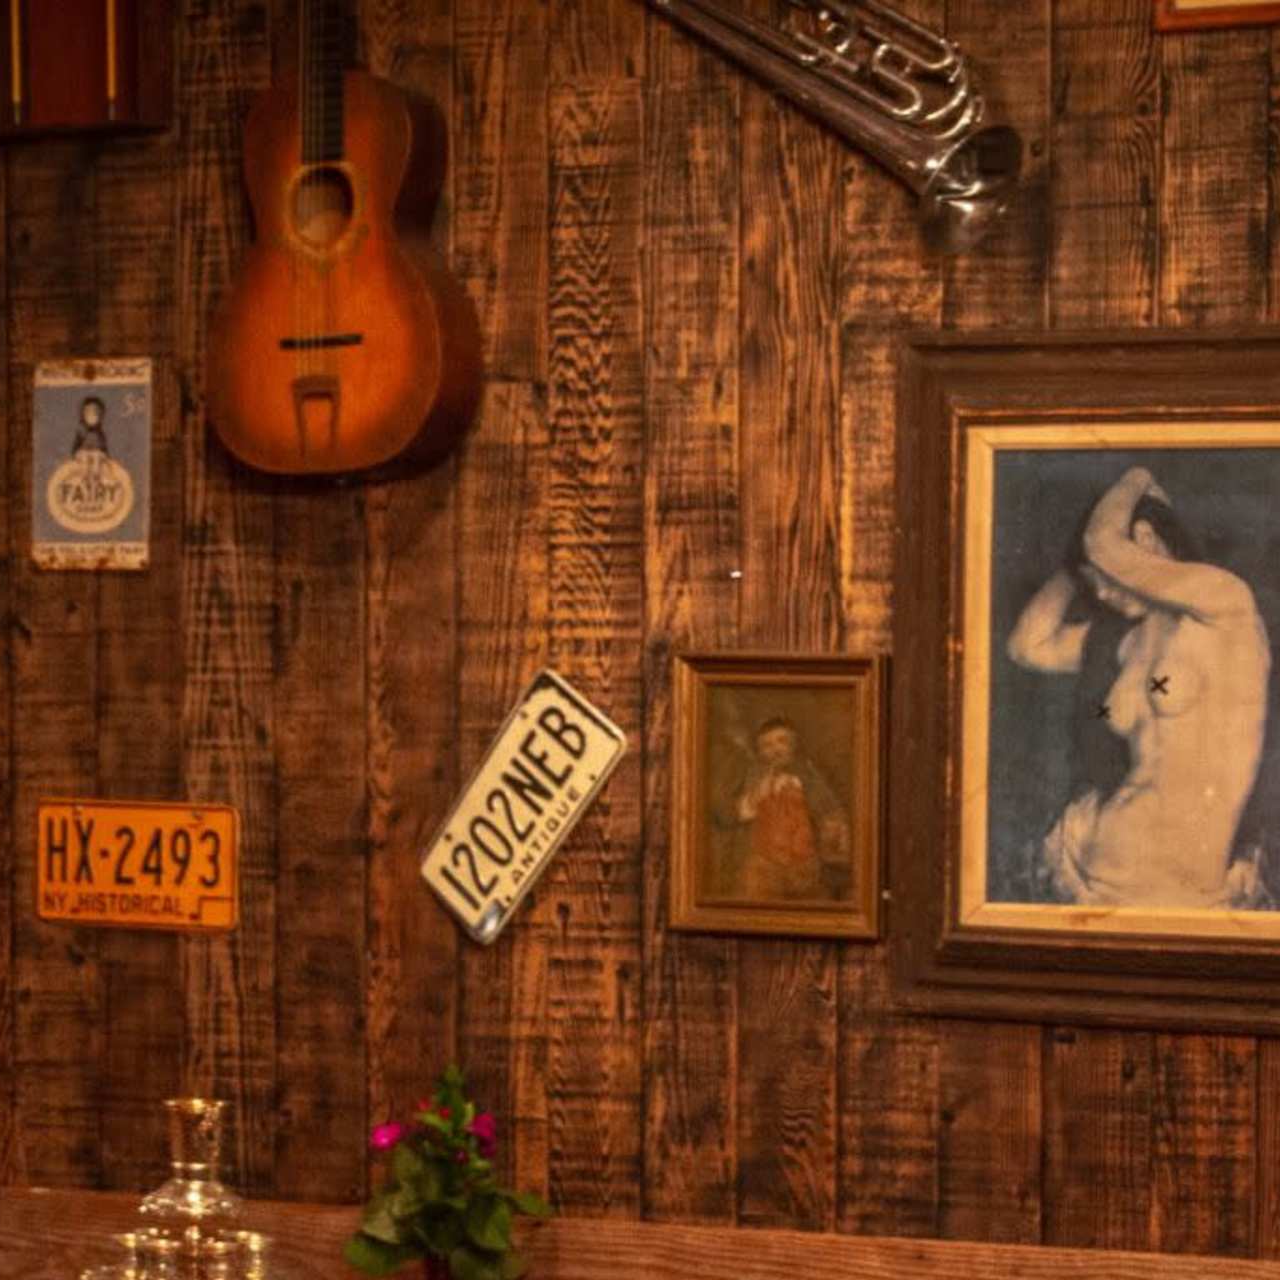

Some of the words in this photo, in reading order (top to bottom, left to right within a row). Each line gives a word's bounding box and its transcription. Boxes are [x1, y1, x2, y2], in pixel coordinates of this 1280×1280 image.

[60, 482, 121, 504] FAIRY
[440, 706, 587, 911] 1202NEB
[512, 787, 581, 884] ANTIQUE
[43, 892, 68, 912] NY
[75, 892, 184, 916] HISTORICAL
